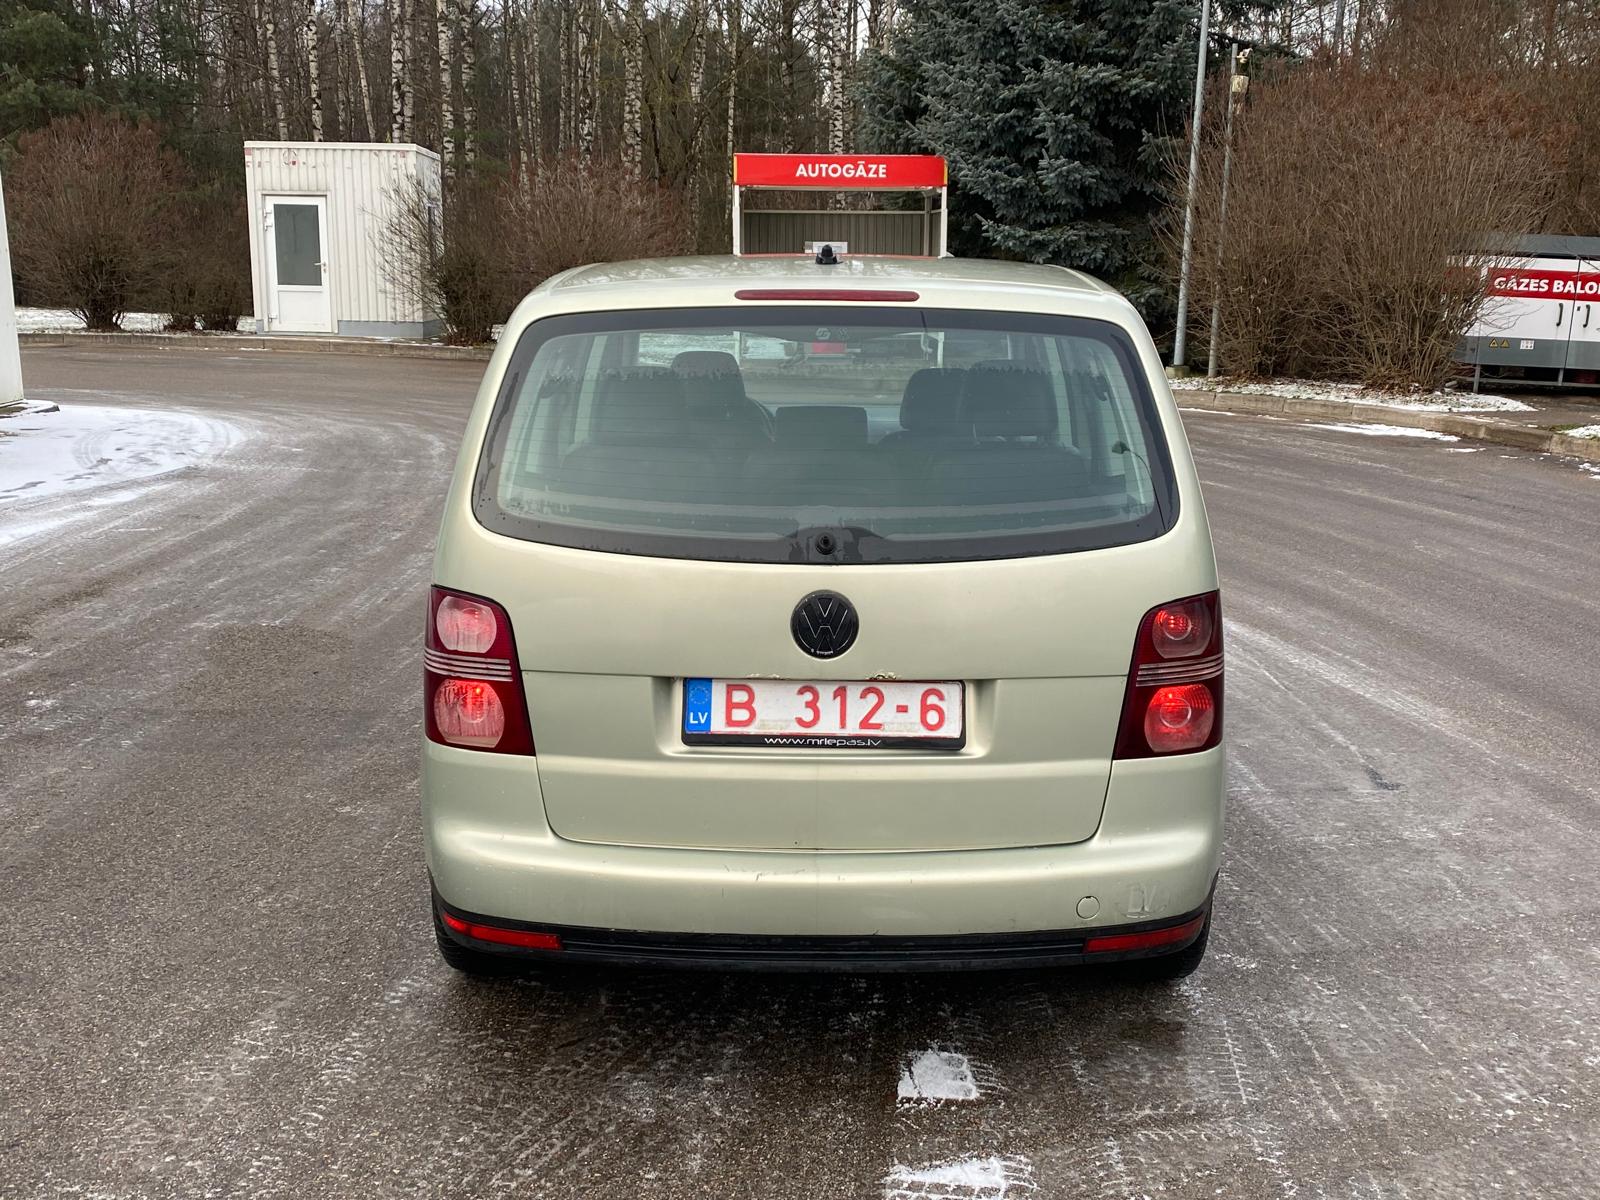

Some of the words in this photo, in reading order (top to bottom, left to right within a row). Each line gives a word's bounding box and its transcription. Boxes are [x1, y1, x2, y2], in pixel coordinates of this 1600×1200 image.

[795, 160, 887, 178] AUTOGĀZE
[1552, 280, 1600, 294] BALO
[725, 684, 757, 728] B
[795, 685, 946, 731] 312-6
[689, 711, 709, 725] LV
